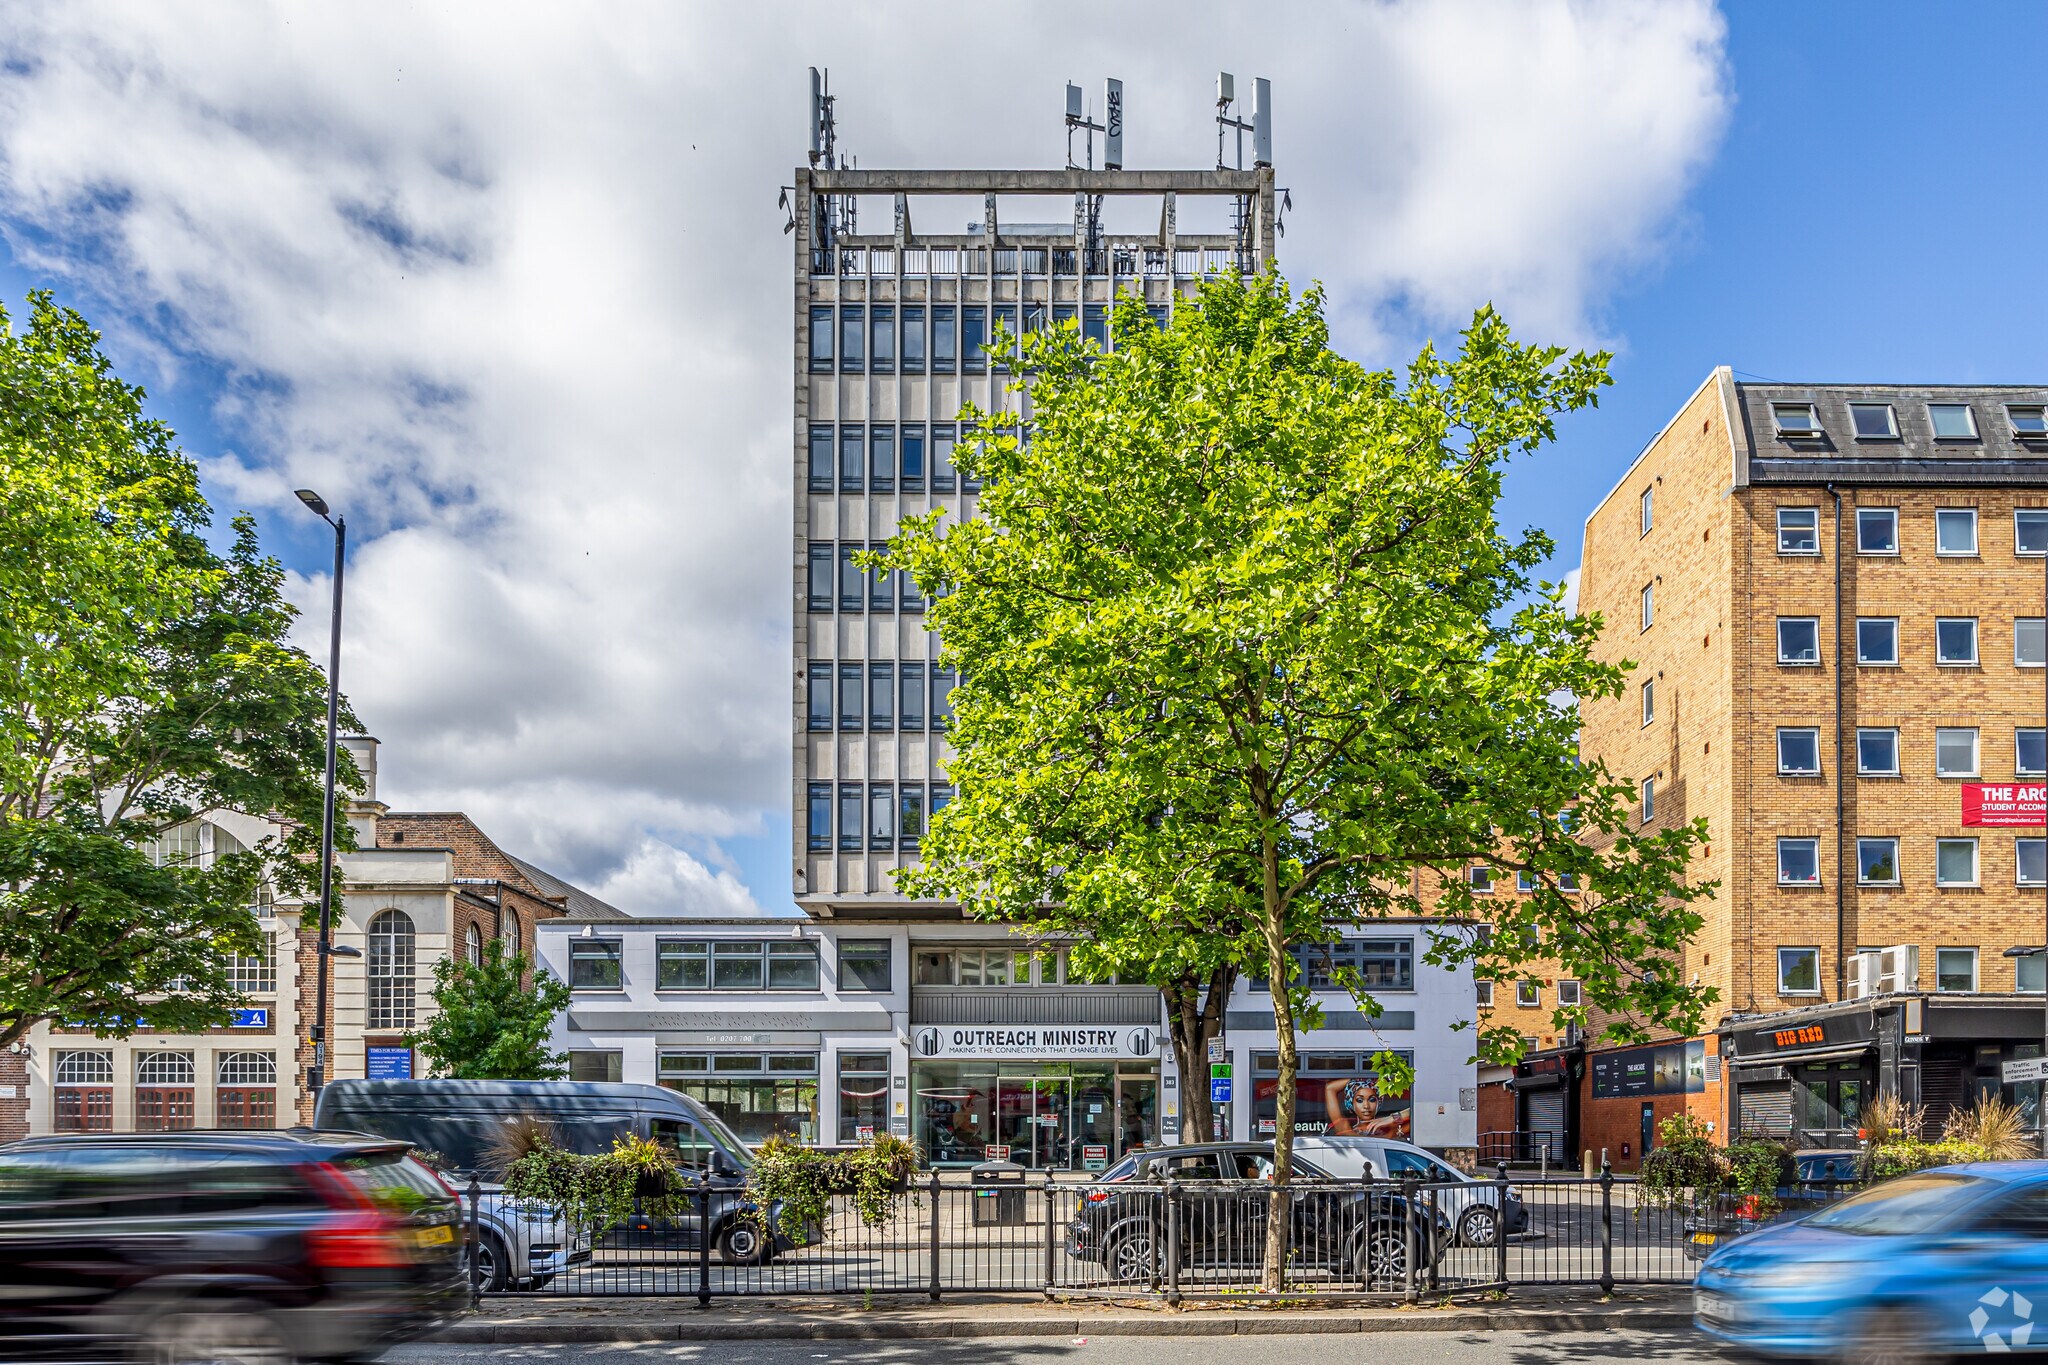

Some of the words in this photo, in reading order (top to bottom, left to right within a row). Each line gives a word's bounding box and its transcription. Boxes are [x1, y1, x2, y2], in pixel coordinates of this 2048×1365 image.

[1981, 787, 2013, 801] THE
[2016, 787, 2046, 801] ARC
[1981, 803, 2016, 811] STUDENT
[953, 1030, 1036, 1046] OUTREACH
[1042, 1030, 1117, 1046] MINISTRY
[1775, 1030, 1797, 1046] BIG
[1797, 1026, 1824, 1043] RED
[2004, 1066, 2039, 1075] enforcement
[1294, 1121, 1328, 1134] eauty
